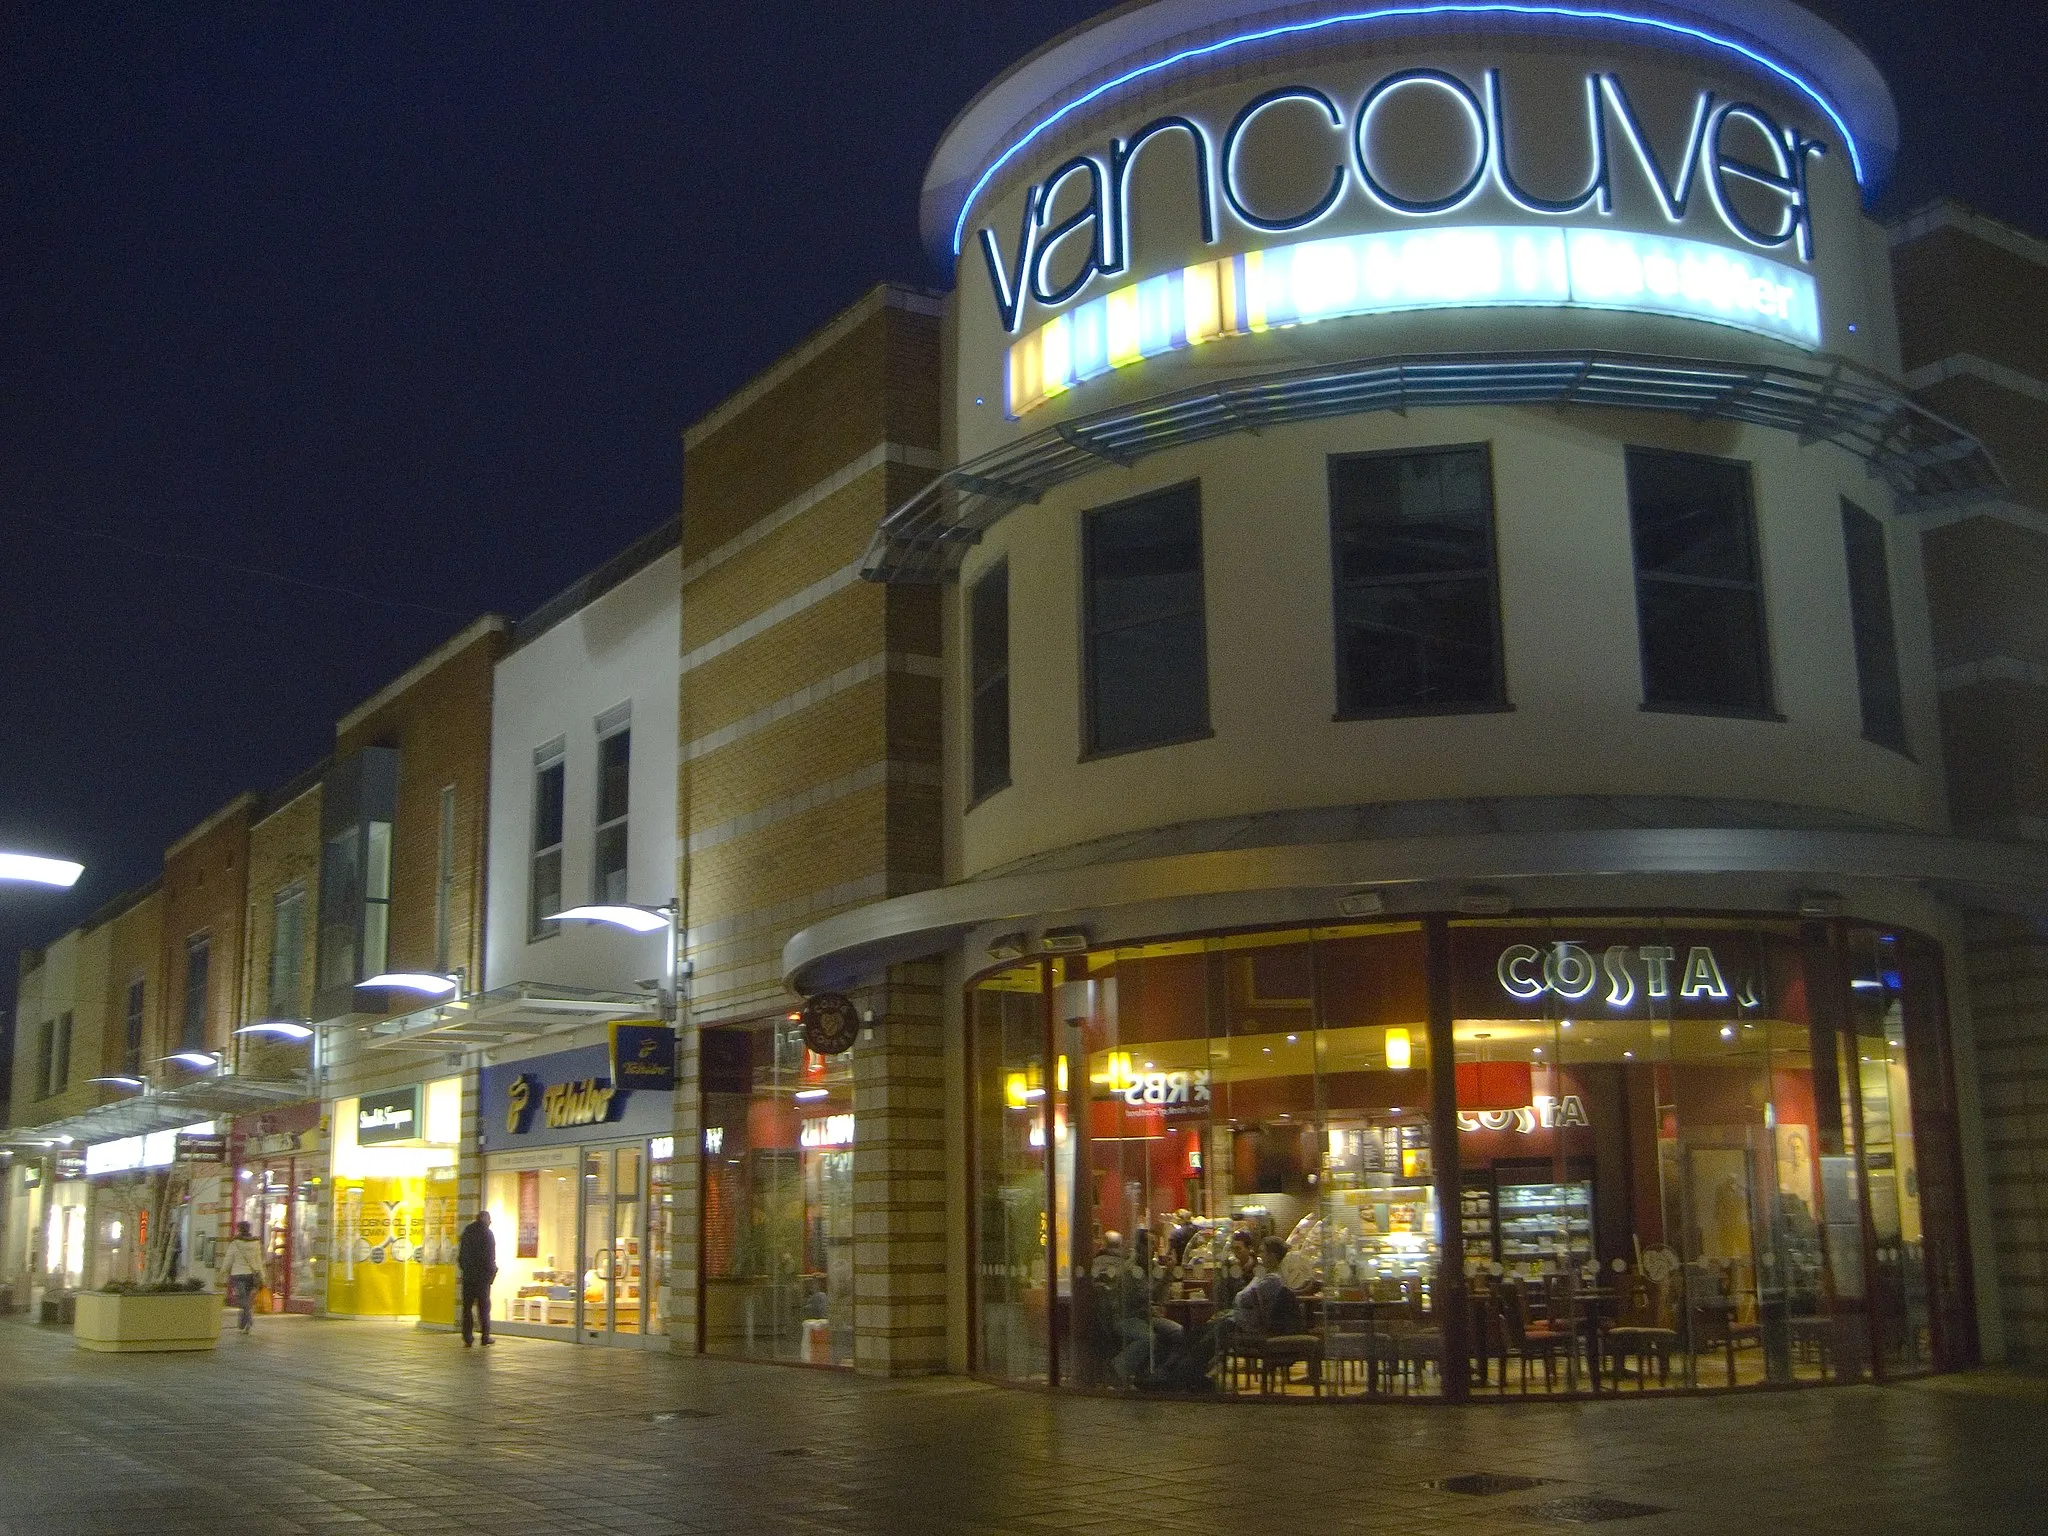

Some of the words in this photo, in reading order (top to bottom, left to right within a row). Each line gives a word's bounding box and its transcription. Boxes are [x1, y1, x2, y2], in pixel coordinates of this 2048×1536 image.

[979, 67, 1828, 333] vancouver
[1497, 944, 1729, 1006] COSTA
[542, 1078, 617, 1129] Tchibo
